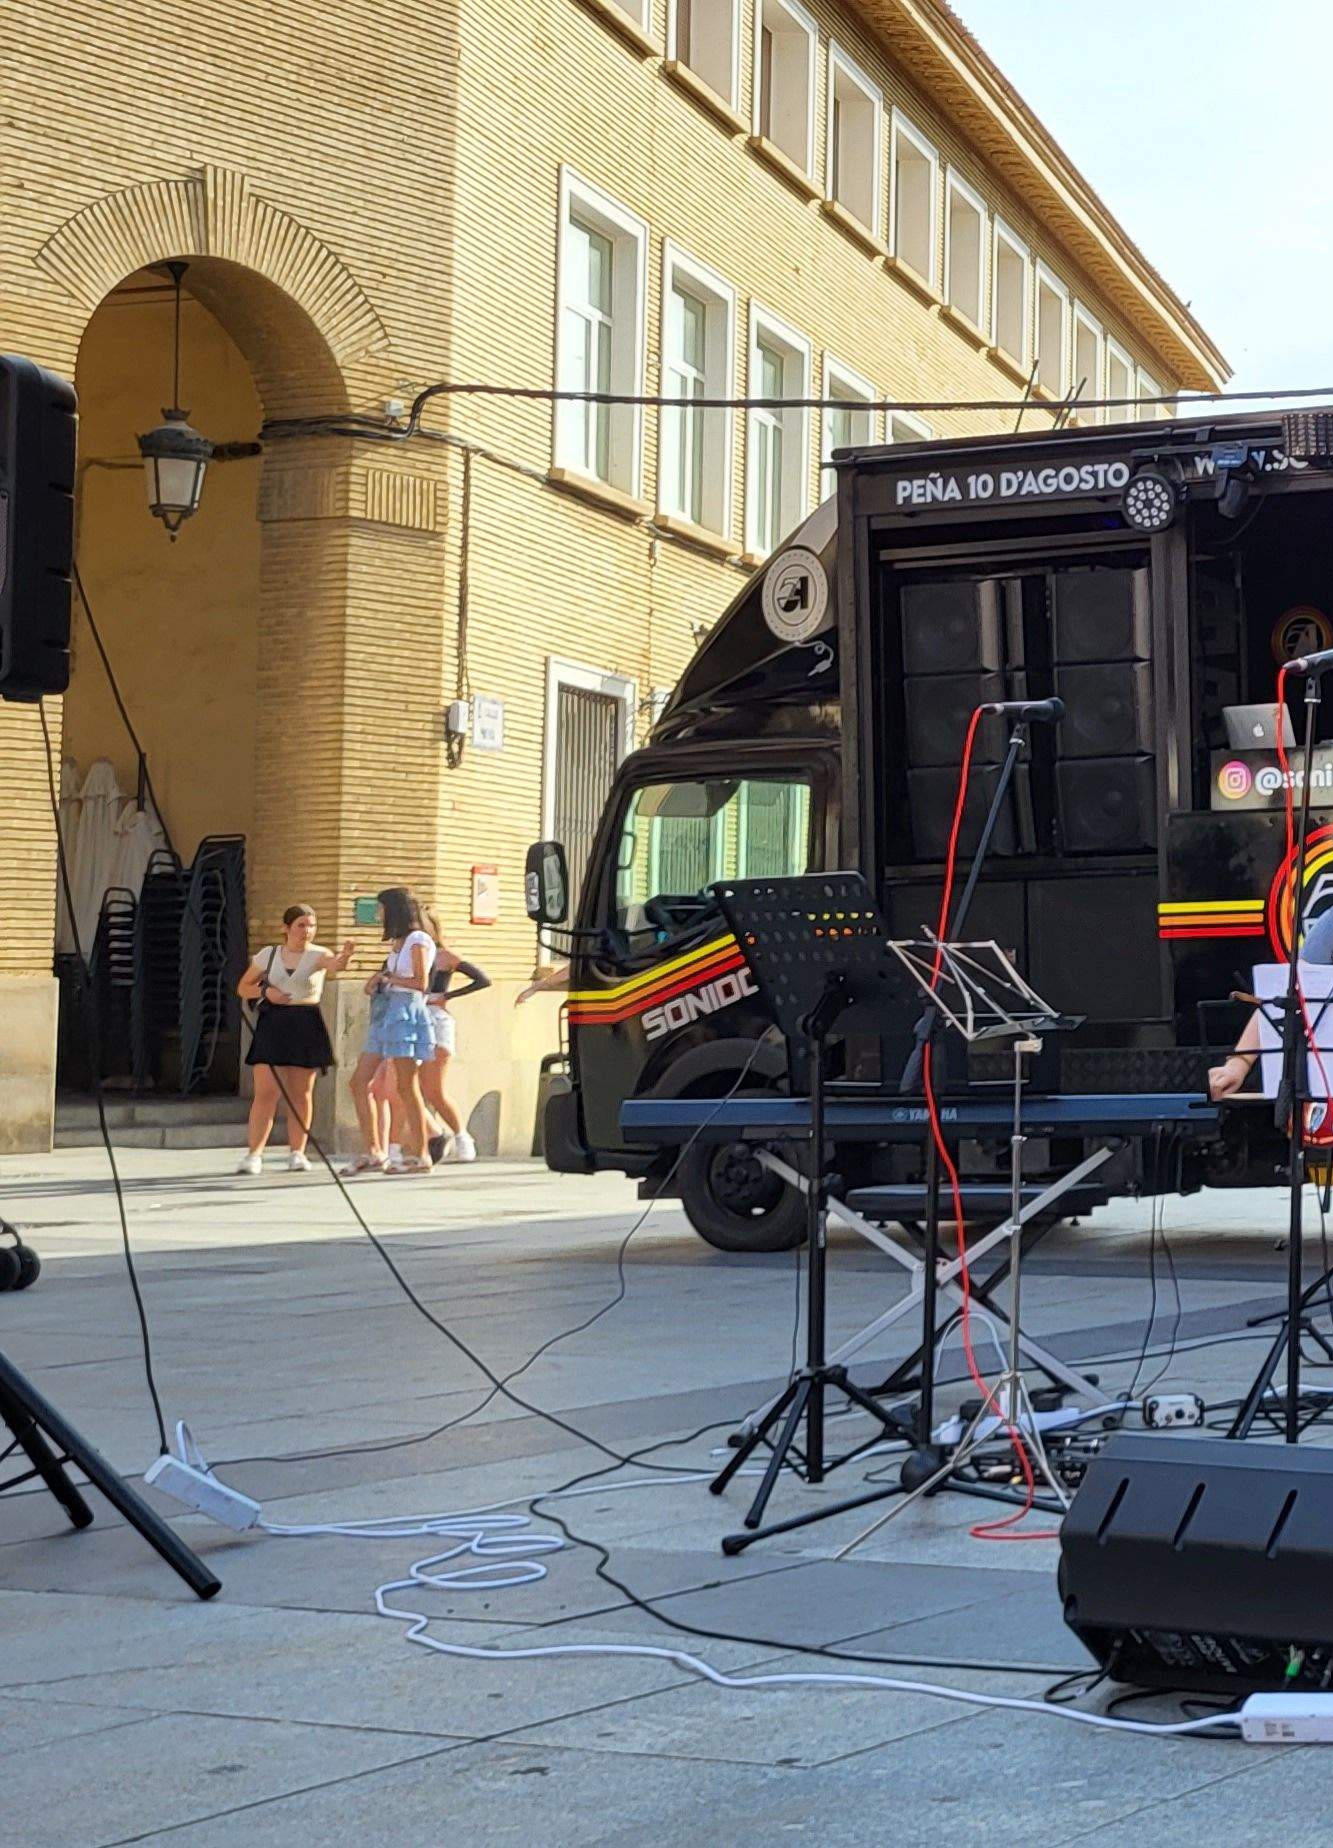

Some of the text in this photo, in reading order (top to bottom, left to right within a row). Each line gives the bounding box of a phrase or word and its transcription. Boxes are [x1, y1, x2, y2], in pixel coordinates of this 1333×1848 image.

[896, 461, 1130, 505] PEÑA 10 D'AGOSTO
[908, 1107, 958, 1121] YAMHA
